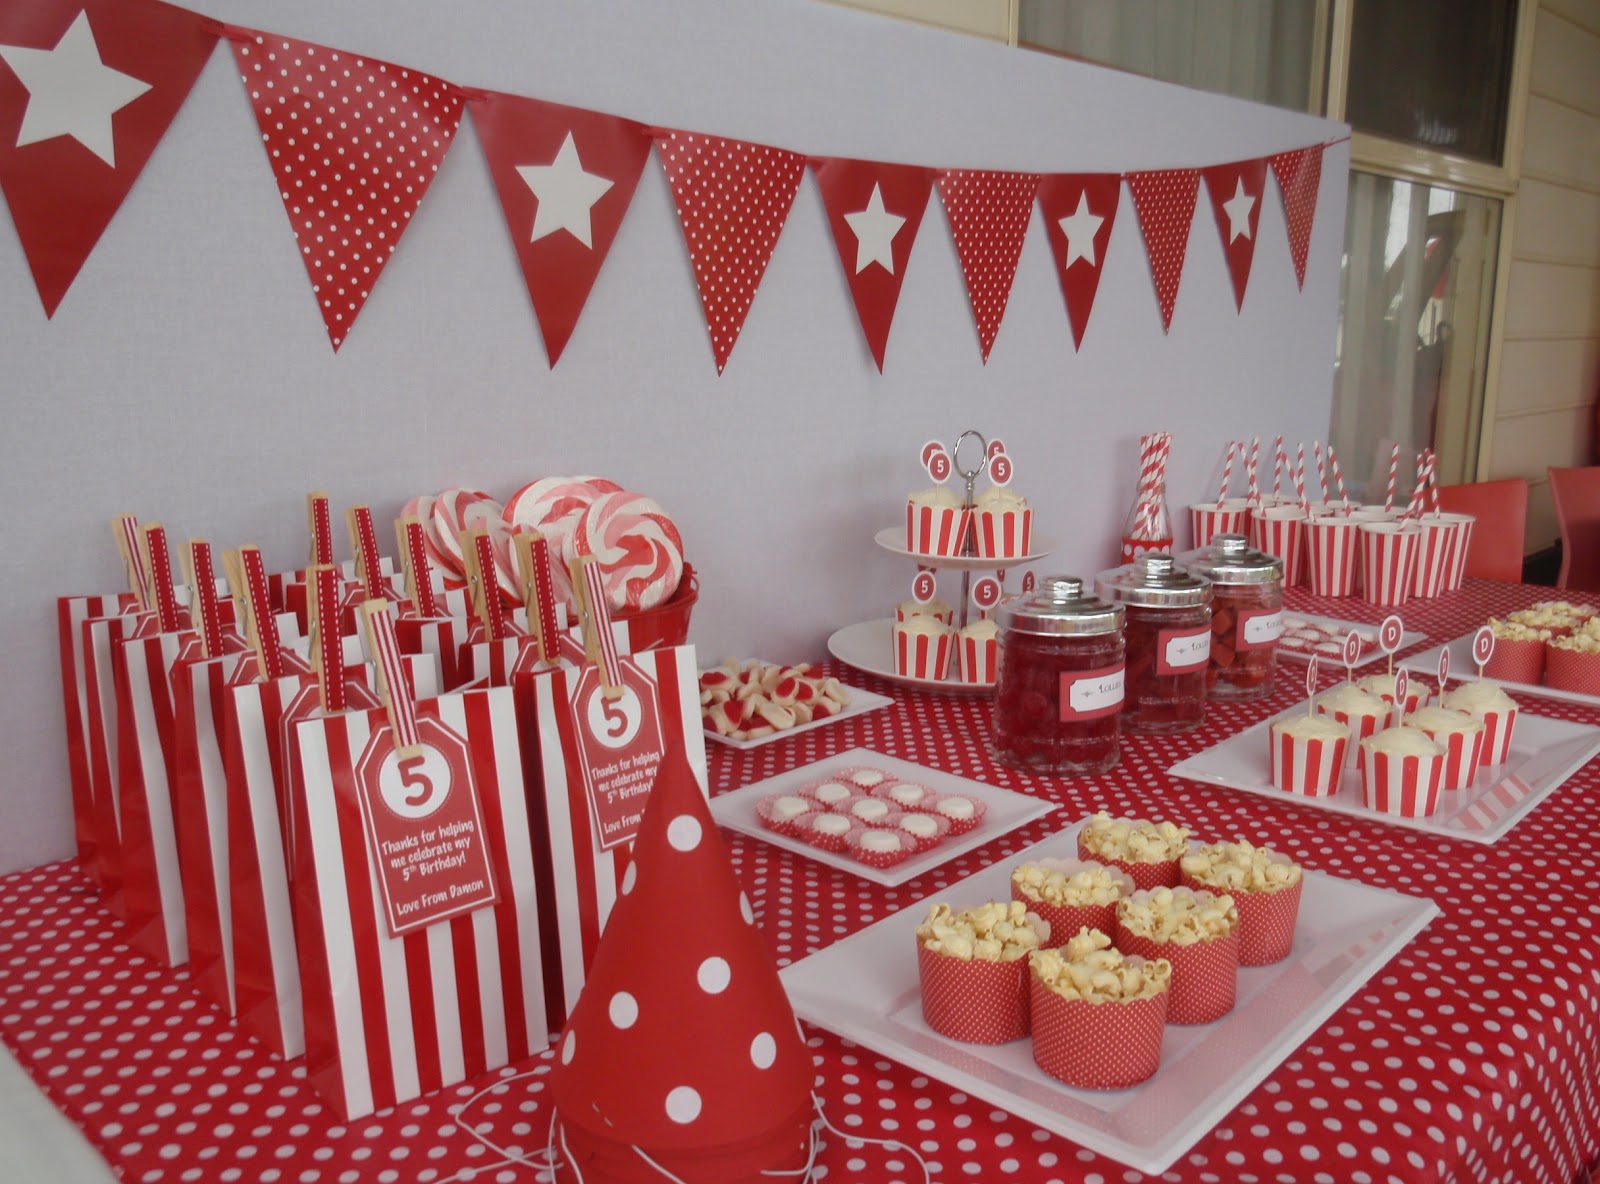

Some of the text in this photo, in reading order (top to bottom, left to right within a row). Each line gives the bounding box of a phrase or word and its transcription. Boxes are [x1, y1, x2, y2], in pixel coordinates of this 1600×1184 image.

[937, 459, 944, 473] 5
[998, 462, 1006, 476] 5
[921, 580, 929, 594] 5
[983, 585, 991, 599] 5
[1388, 626, 1396, 642] D
[1350, 640, 1356, 657] D
[1481, 637, 1489, 653] D
[1399, 678, 1405, 696] D
[600, 696, 629, 738] 5
[591, 751, 660, 780] Thanks for helping
[397, 755, 434, 807] 5
[598, 765, 658, 792] me celebrate my
[603, 813, 641, 834] Love From
[382, 820, 475, 856] Thanks for helping
[390, 836, 471, 869] me celebrate my
[402, 850, 467, 882] 5th Birthday!
[396, 879, 484, 916] Love From Damon
